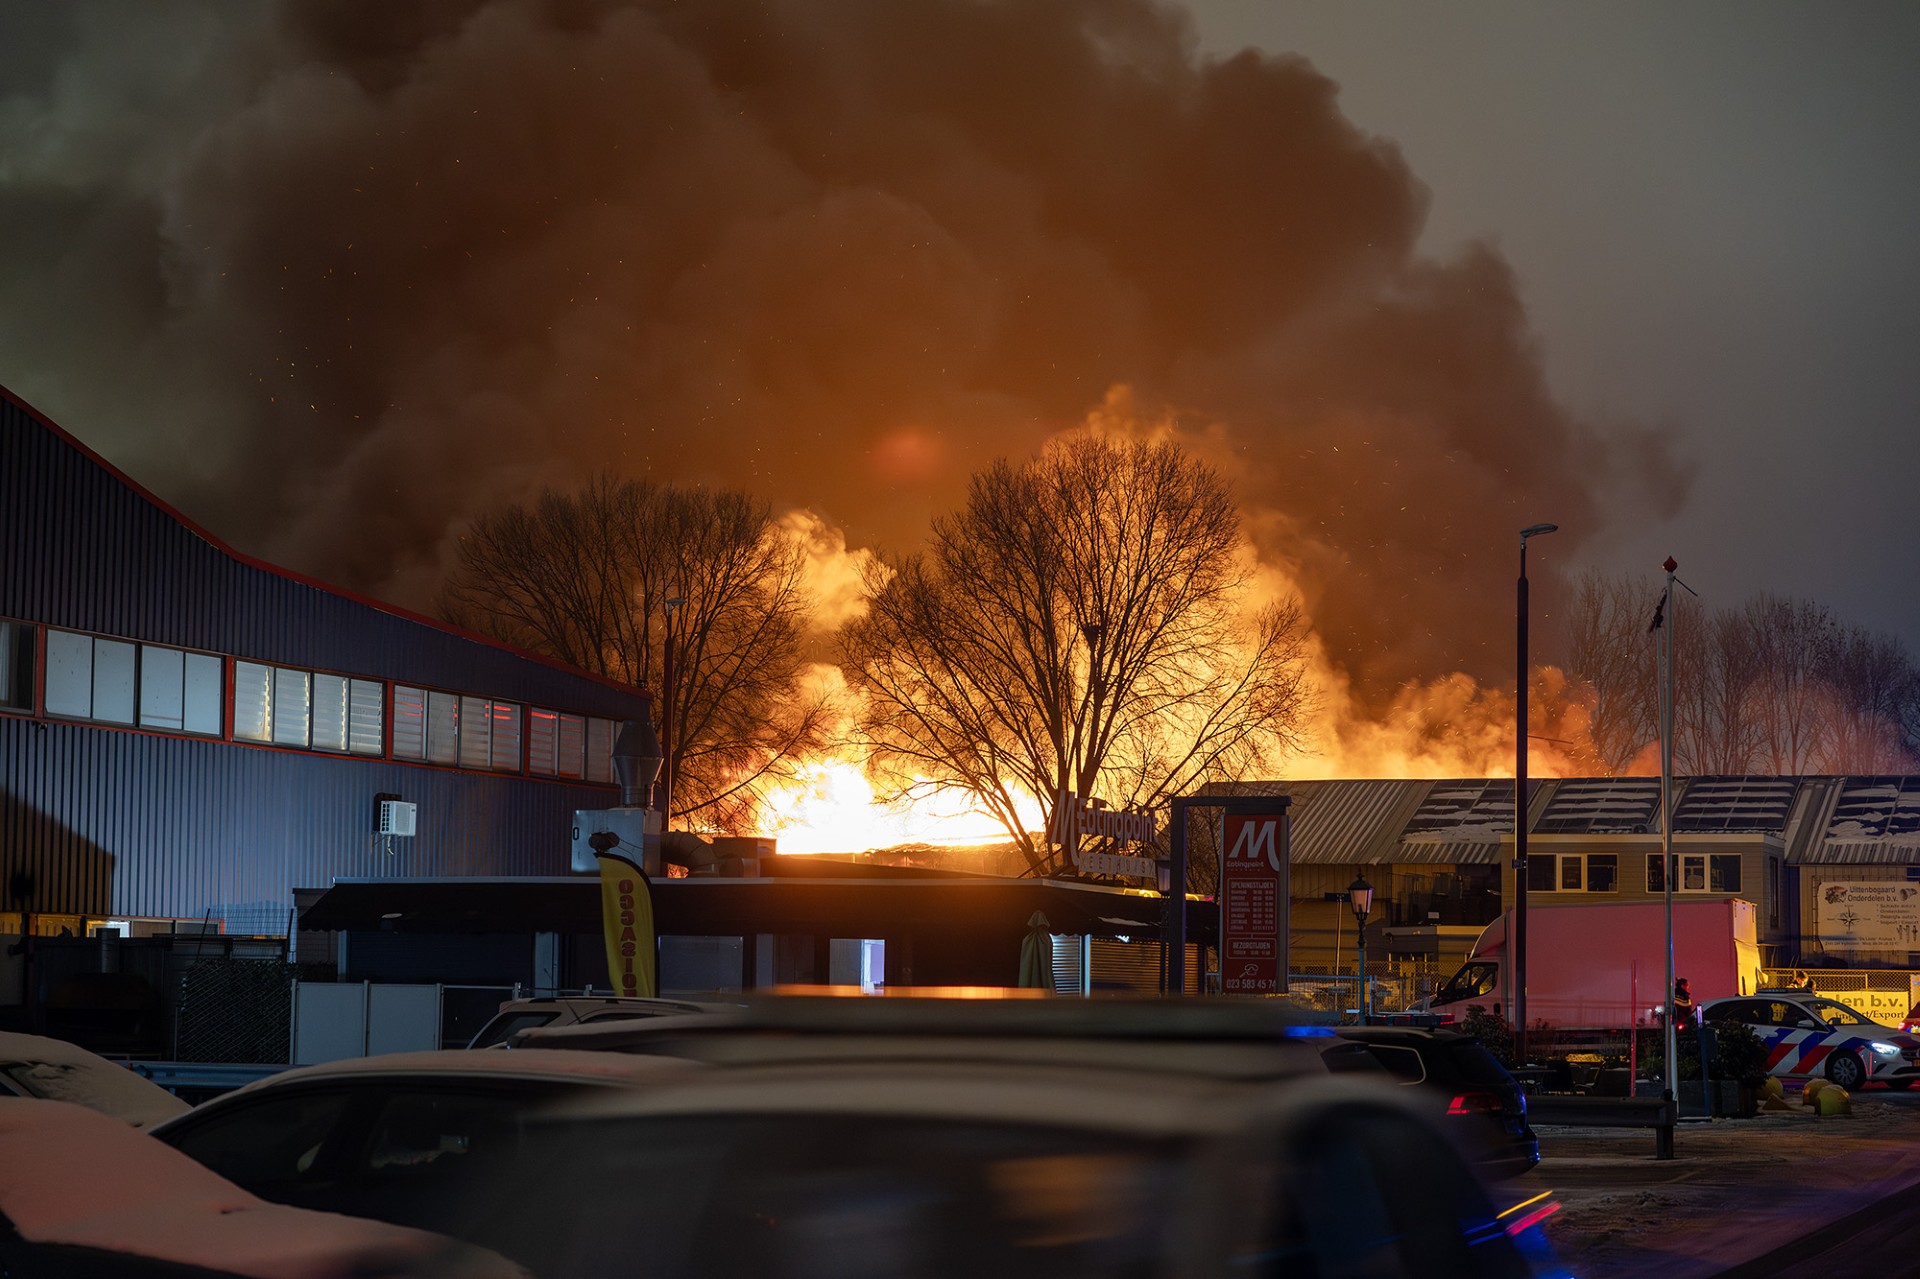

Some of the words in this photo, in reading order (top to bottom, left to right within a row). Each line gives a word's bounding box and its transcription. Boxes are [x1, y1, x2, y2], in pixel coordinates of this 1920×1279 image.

[1077, 797, 1159, 849] Eatingpoint
[1228, 820, 1280, 872] M
[1226, 860, 1264, 869] Eatingpoint
[1230, 881, 1274, 889] OPENINGSTIJDEN
[1226, 978, 1240, 989] 023
[1242, 978, 1255, 989] 583
[1257, 978, 1266, 989] 45
[1870, 994, 1903, 1007] b.v.
